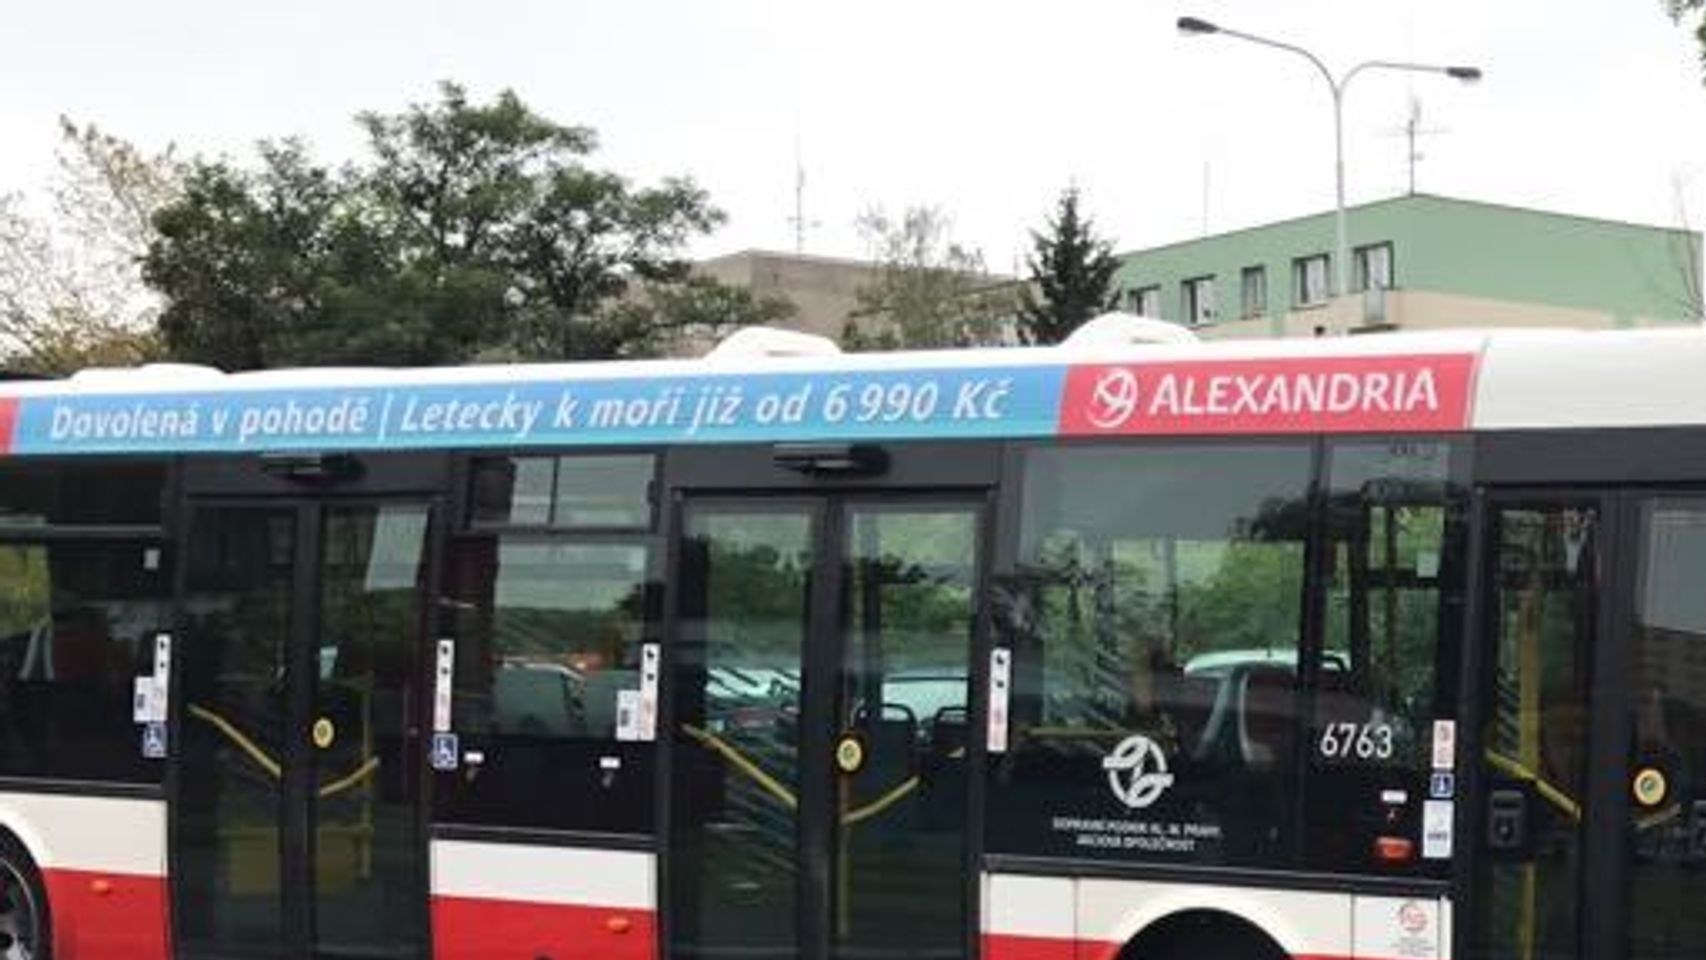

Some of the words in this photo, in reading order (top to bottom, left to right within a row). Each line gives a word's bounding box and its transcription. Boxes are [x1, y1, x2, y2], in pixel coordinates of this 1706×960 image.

[50, 401, 201, 439] Dovolená
[210, 408, 230, 433] v
[238, 395, 370, 443] pohodě
[399, 392, 543, 438] Letecky
[553, 390, 579, 429] k
[588, 387, 684, 428] moři
[687, 384, 742, 436] již
[755, 383, 812, 424] od
[952, 377, 1014, 420] Kč
[1148, 367, 1438, 416] ALEXANDRIA
[1320, 722, 1392, 758] 6763
